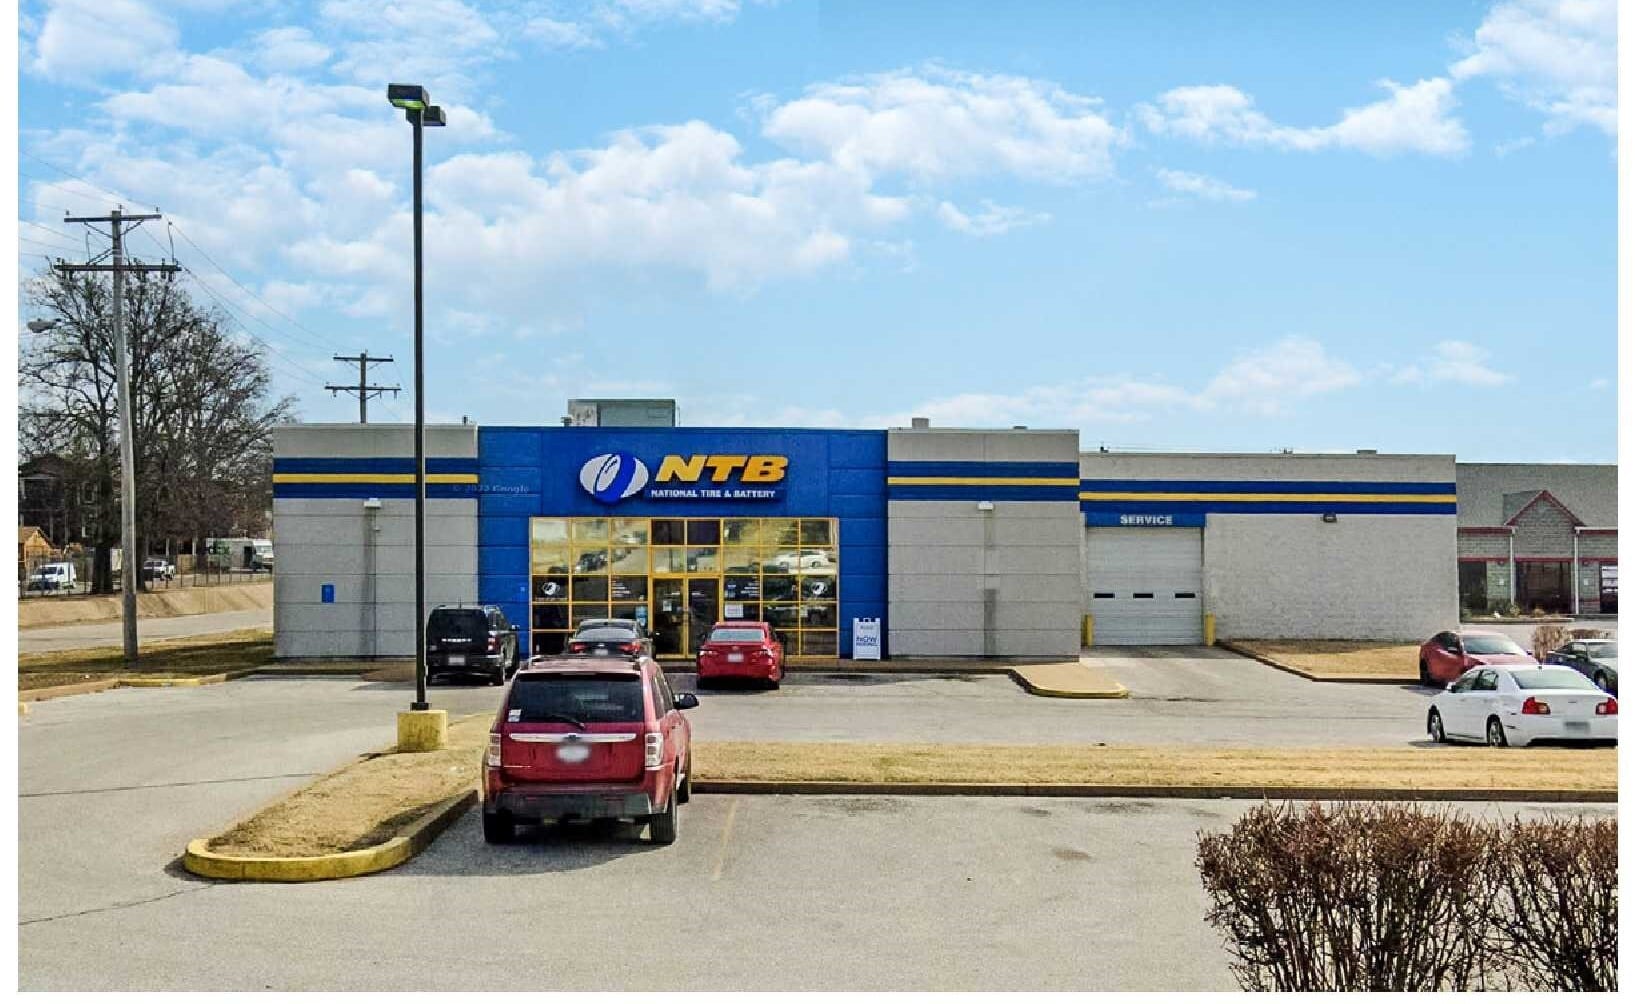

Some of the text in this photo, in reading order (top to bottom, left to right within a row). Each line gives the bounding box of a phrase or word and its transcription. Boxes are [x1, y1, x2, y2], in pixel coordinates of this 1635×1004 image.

[655, 454, 789, 482] NTB
[651, 489, 776, 498] NATIONAL TIRE & BATTERY
[1120, 514, 1173, 525] SERVICE
